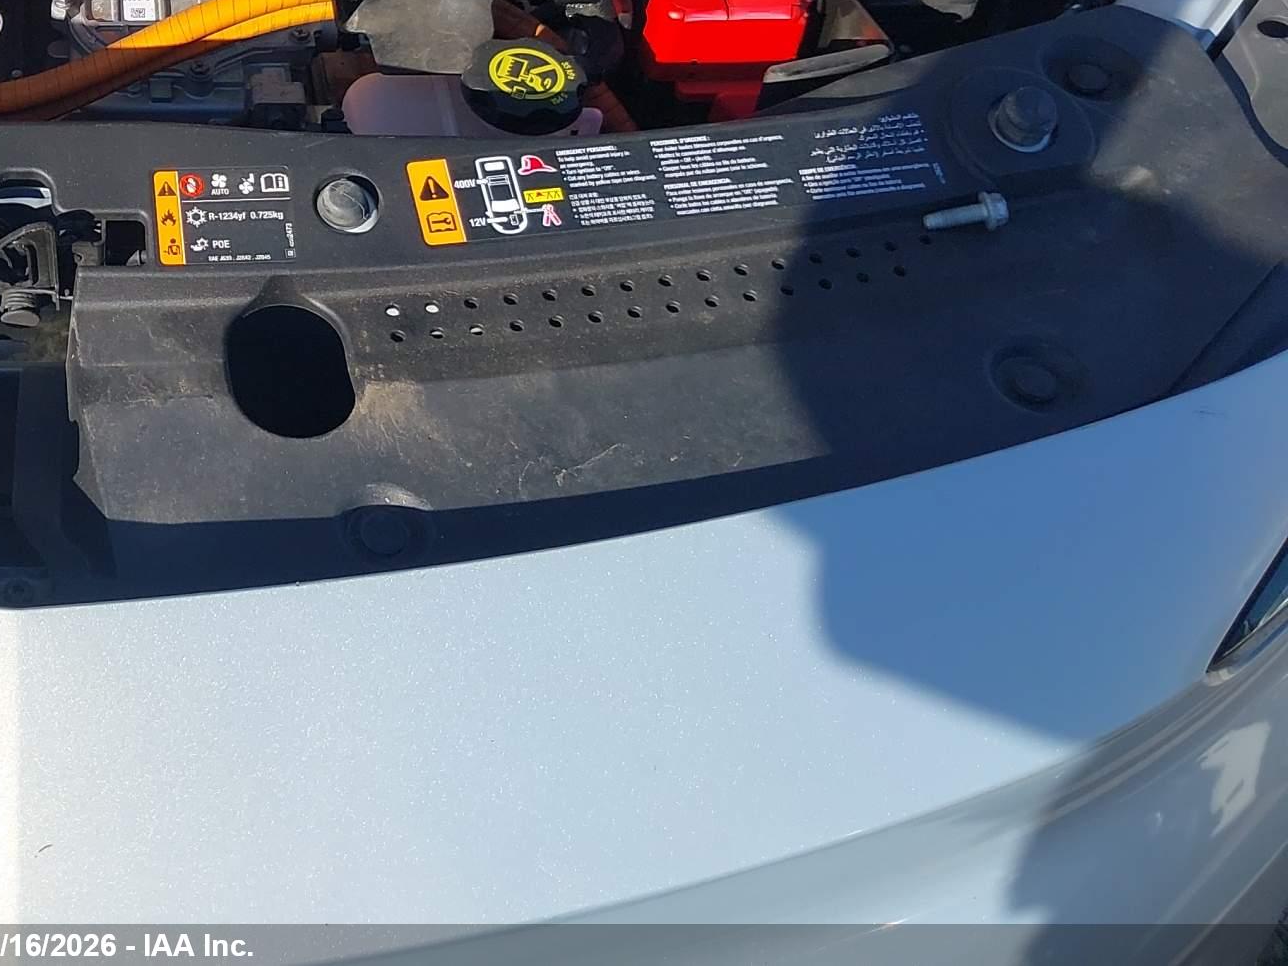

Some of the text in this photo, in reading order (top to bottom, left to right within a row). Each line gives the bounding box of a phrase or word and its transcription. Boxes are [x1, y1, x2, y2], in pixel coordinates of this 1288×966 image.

[454, 179, 476, 189] 400V
[208, 211, 284, 222] R-1234yf 0.725kg
[469, 217, 487, 227] 12V
[212, 240, 231, 249] POE
